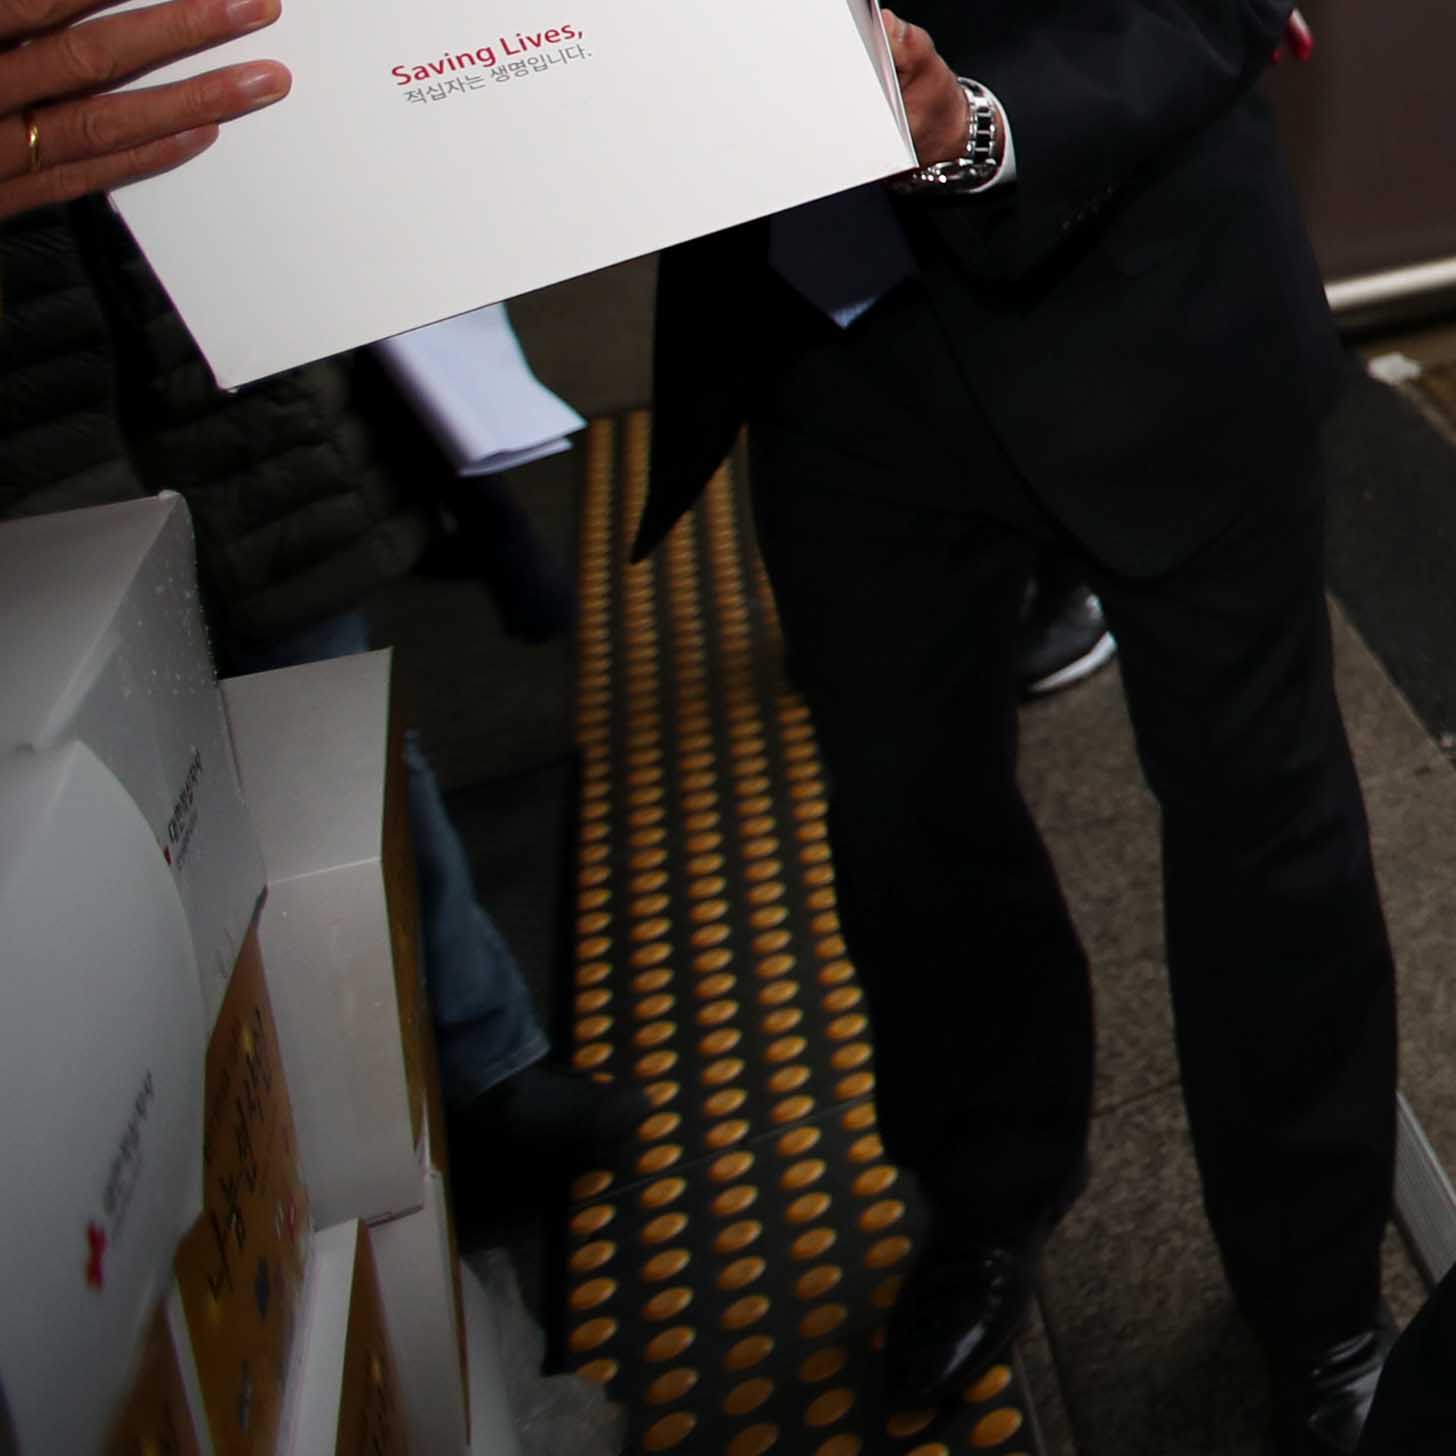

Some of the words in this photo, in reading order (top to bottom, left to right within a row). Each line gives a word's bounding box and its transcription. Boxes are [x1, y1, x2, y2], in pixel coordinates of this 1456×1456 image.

[391, 46, 497, 86] Saving
[499, 24, 584, 57] Lives,
[403, 74, 487, 105] 적십자는
[490, 44, 592, 83] 생명입니다.
